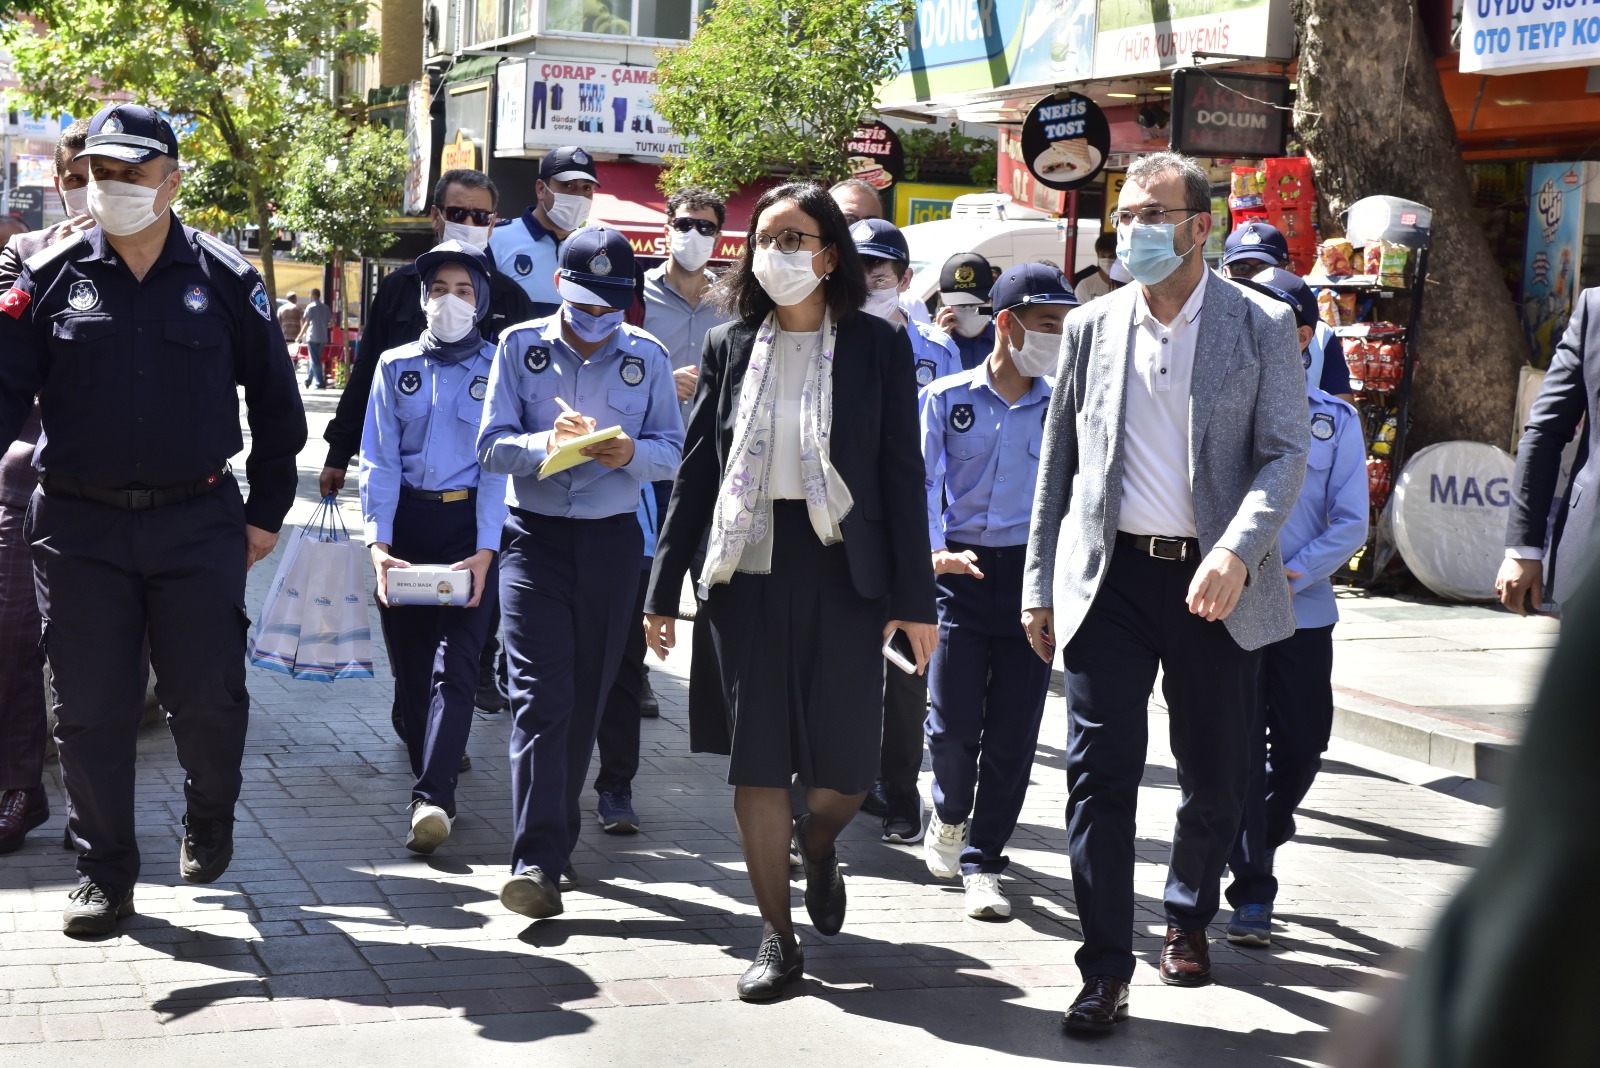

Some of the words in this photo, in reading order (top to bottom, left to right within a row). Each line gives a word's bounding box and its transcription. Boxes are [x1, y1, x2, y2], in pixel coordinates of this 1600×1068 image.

[1124, 31, 1150, 62] HÜR
[1153, 17, 1230, 57] KURUYEMİŞ
[1474, 27, 1511, 55] OTO
[1517, 21, 1567, 52] TEYP
[541, 63, 596, 82] ÇORAP
[551, 115, 577, 124] dündar
[1039, 99, 1087, 121] NEFİS
[1197, 110, 1267, 129] DOLUM
[554, 124, 573, 132] çorap
[855, 126, 887, 140] EFİS
[1045, 120, 1086, 139] TOST
[635, 142, 665, 153] TUTKU
[847, 140, 892, 155] OSİSLİ
